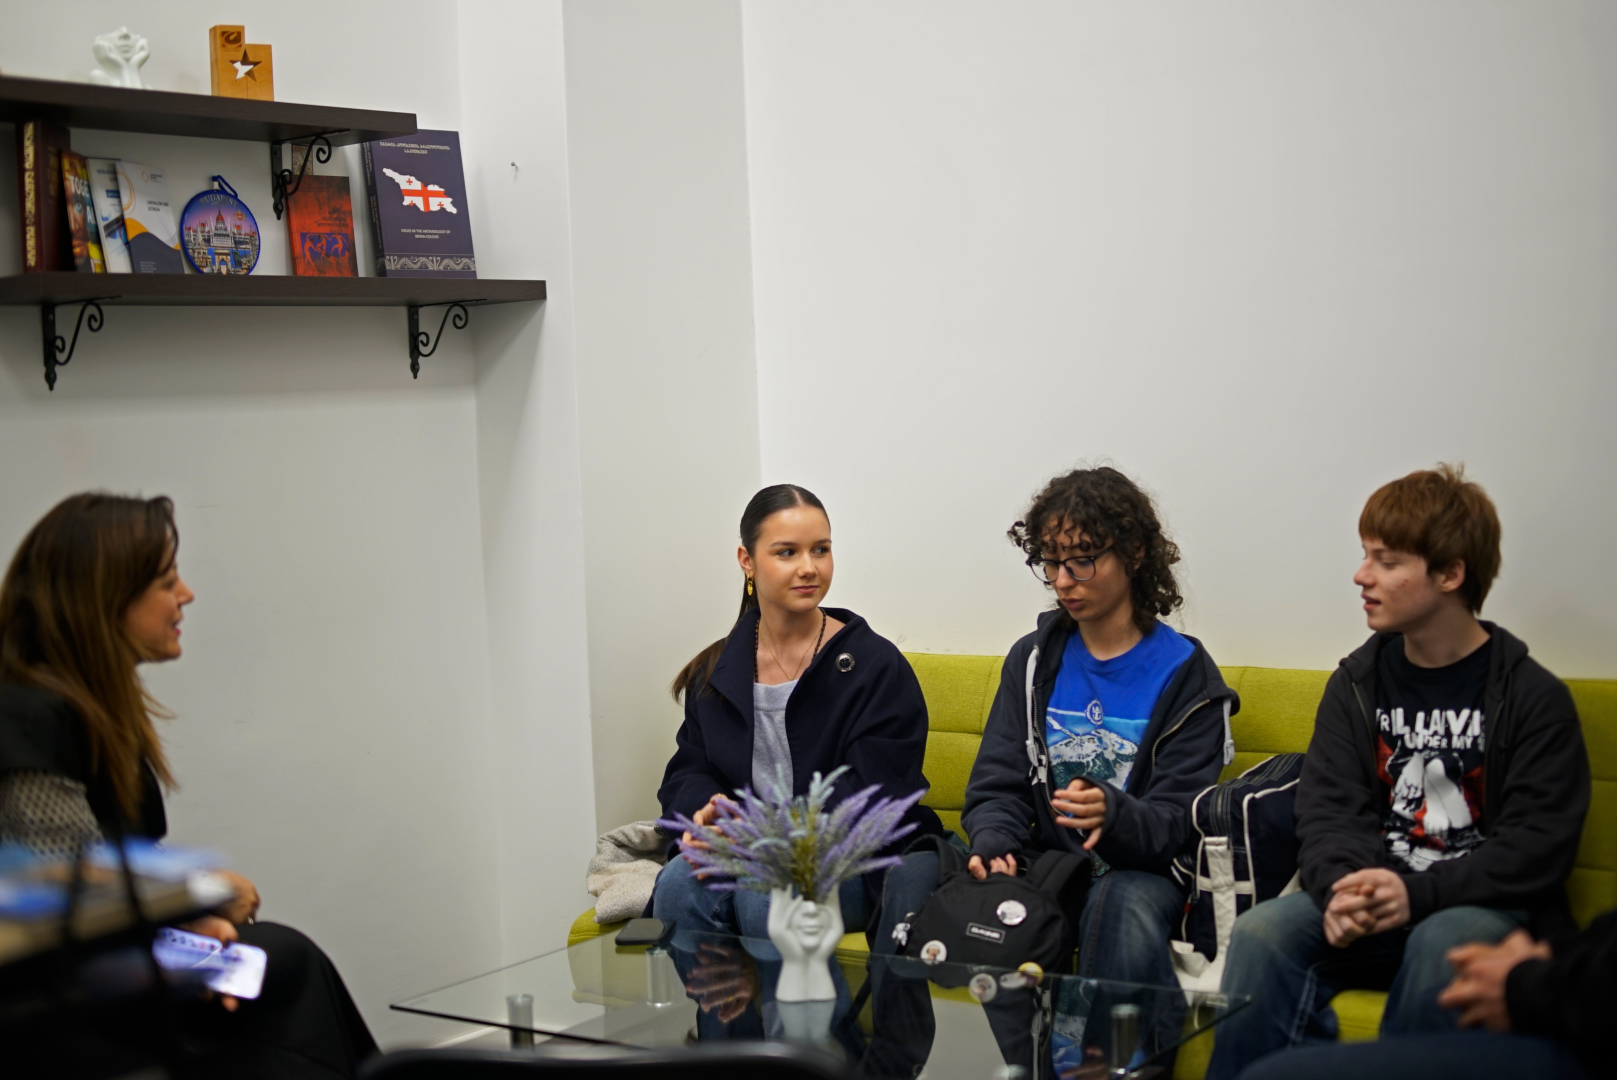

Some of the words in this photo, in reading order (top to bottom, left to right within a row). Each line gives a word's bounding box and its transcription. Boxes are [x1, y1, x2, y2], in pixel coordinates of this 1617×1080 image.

[199, 193, 238, 208] BUDAPEST
[1403, 733, 1448, 750] UNDER
[1451, 735, 1474, 750] MY
